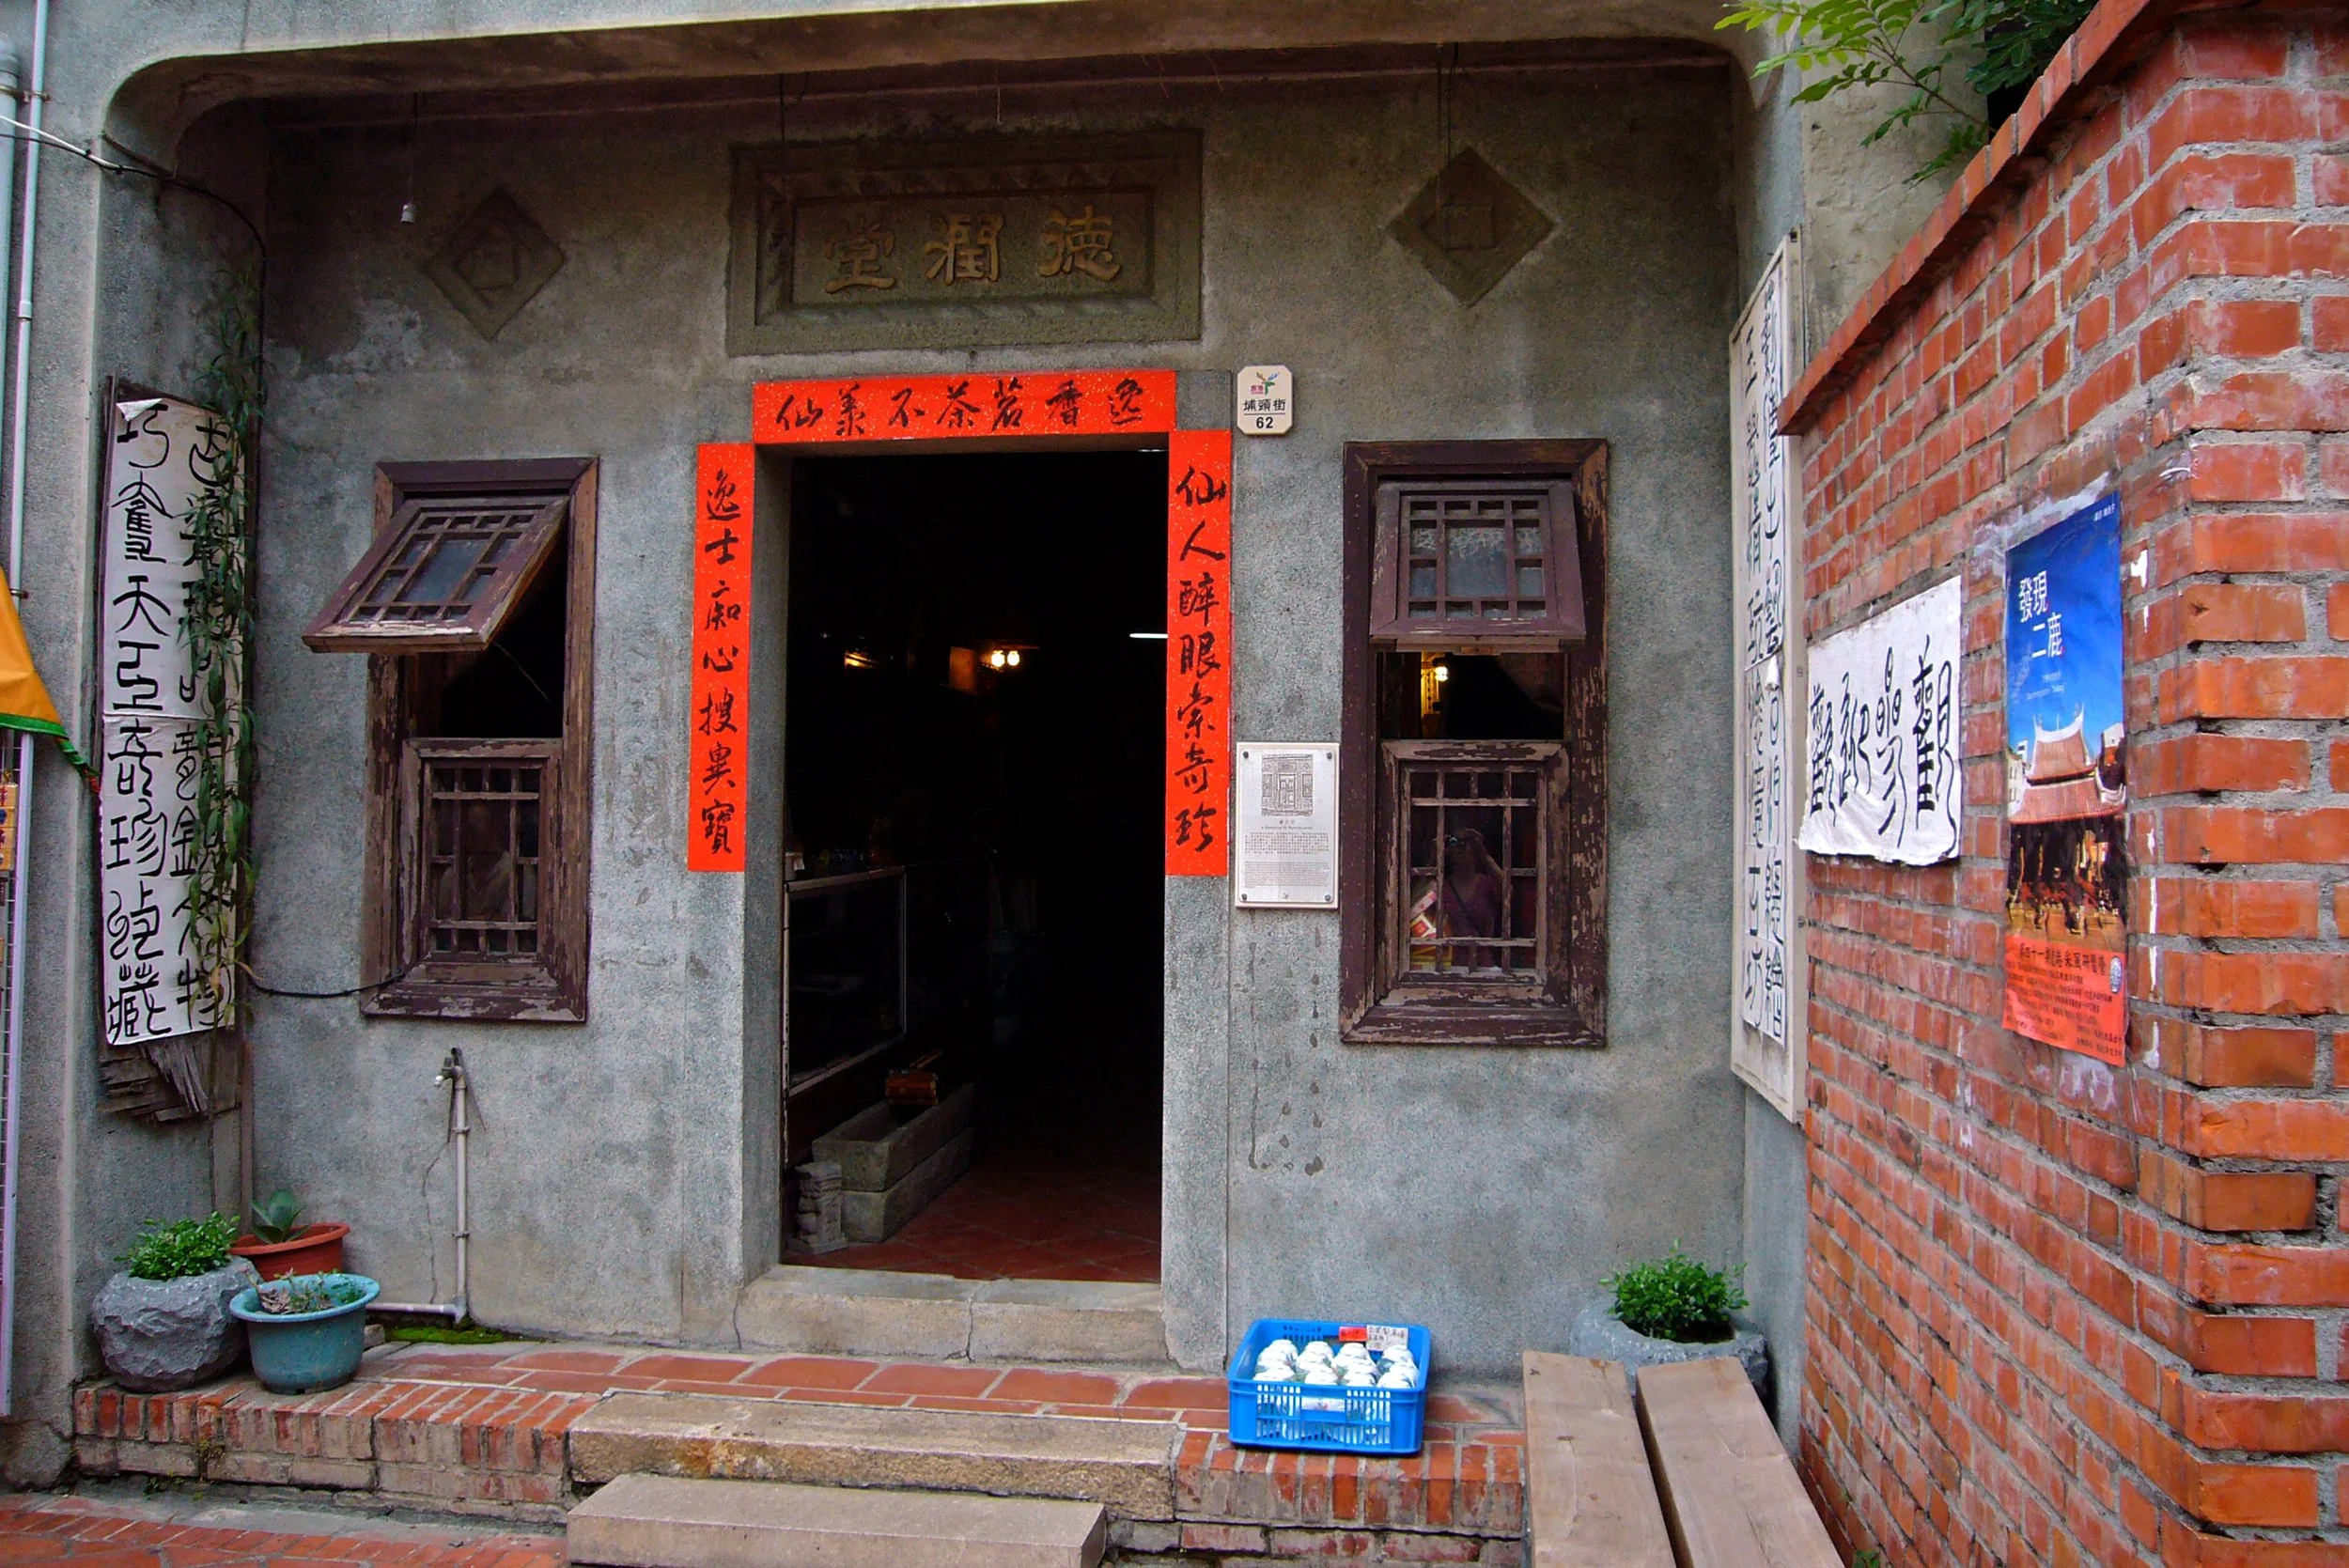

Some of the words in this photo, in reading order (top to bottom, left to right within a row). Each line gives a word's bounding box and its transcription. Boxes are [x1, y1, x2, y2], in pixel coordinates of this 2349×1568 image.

[1243, 398, 1286, 411] 埔頭街
[1256, 416, 1273, 428] 62
[2019, 569, 2048, 624] 發現
[2031, 612, 2062, 658] 二鹿
